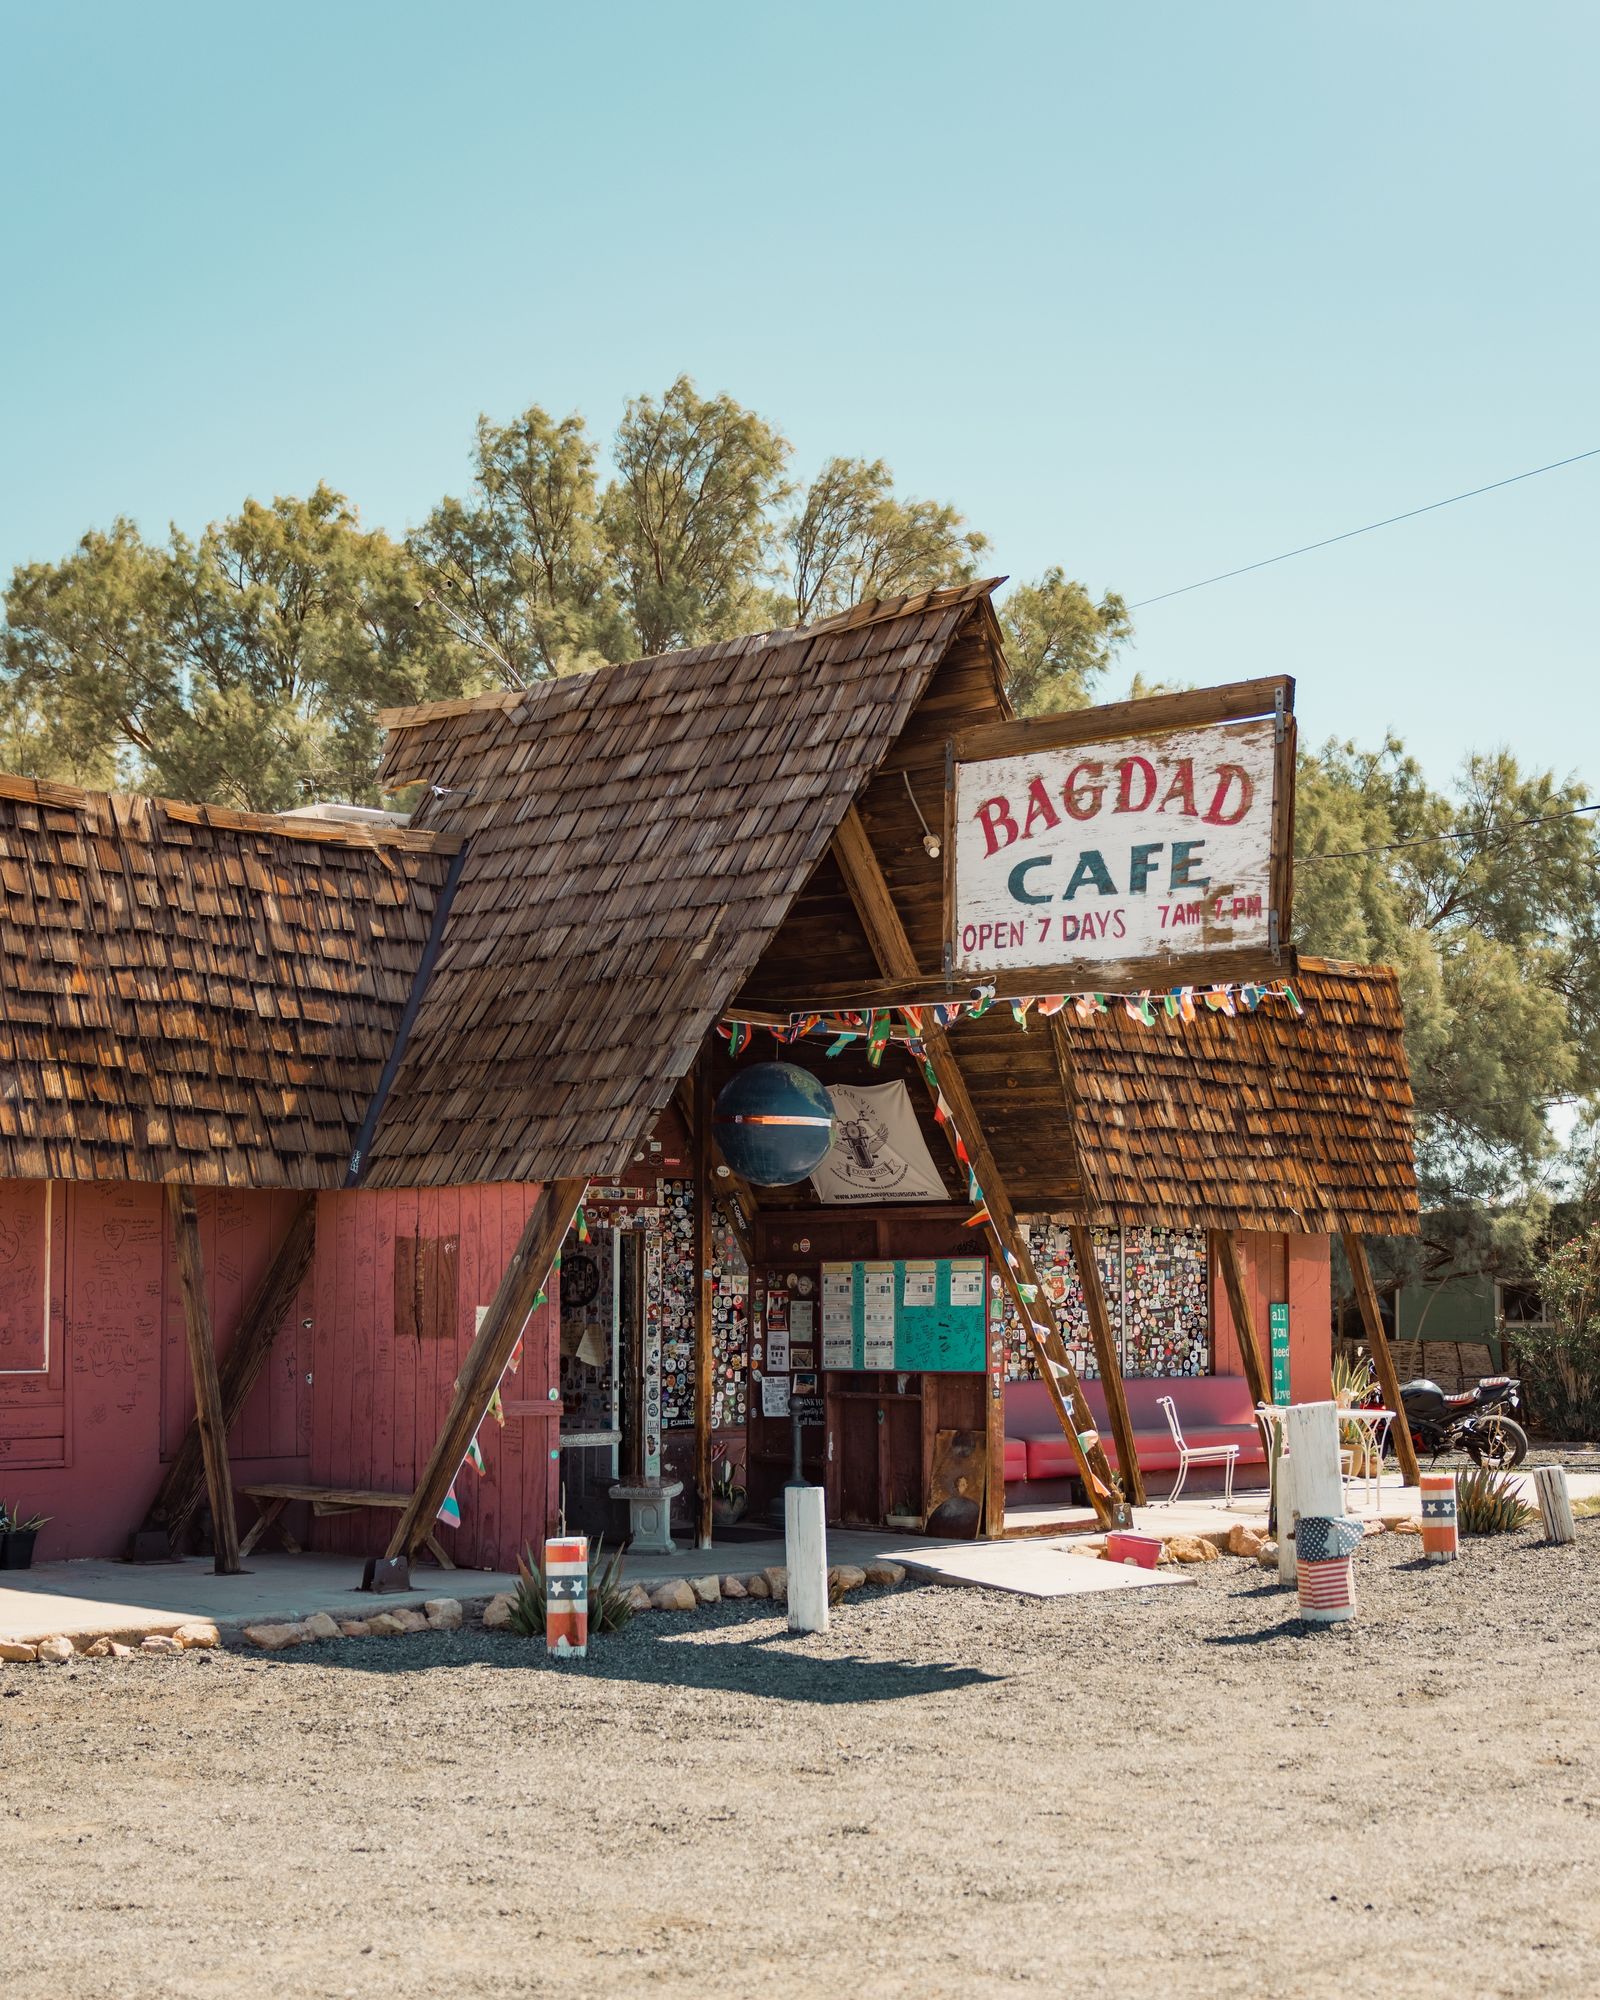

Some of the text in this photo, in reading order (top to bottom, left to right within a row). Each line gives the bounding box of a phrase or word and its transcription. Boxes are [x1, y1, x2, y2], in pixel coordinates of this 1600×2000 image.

[974, 756, 1254, 859] BAGDAD
[1007, 840, 1212, 905] CAFE
[962, 921, 1024, 952] OPEN
[1037, 918, 1052, 943] 7
[1062, 908, 1126, 942] DAYS
[1232, 896, 1263, 920] PM
[852, 1166, 888, 1176] EXCURSION
[834, 1190, 929, 1200] WWW.AMERICANVIPEXCURSION.NET
[1272, 1309, 1285, 1320] all
[1272, 1328, 1287, 1339] you
[1273, 1346, 1290, 1357] need
[1274, 1368, 1283, 1380] is
[1274, 1388, 1291, 1400] love
